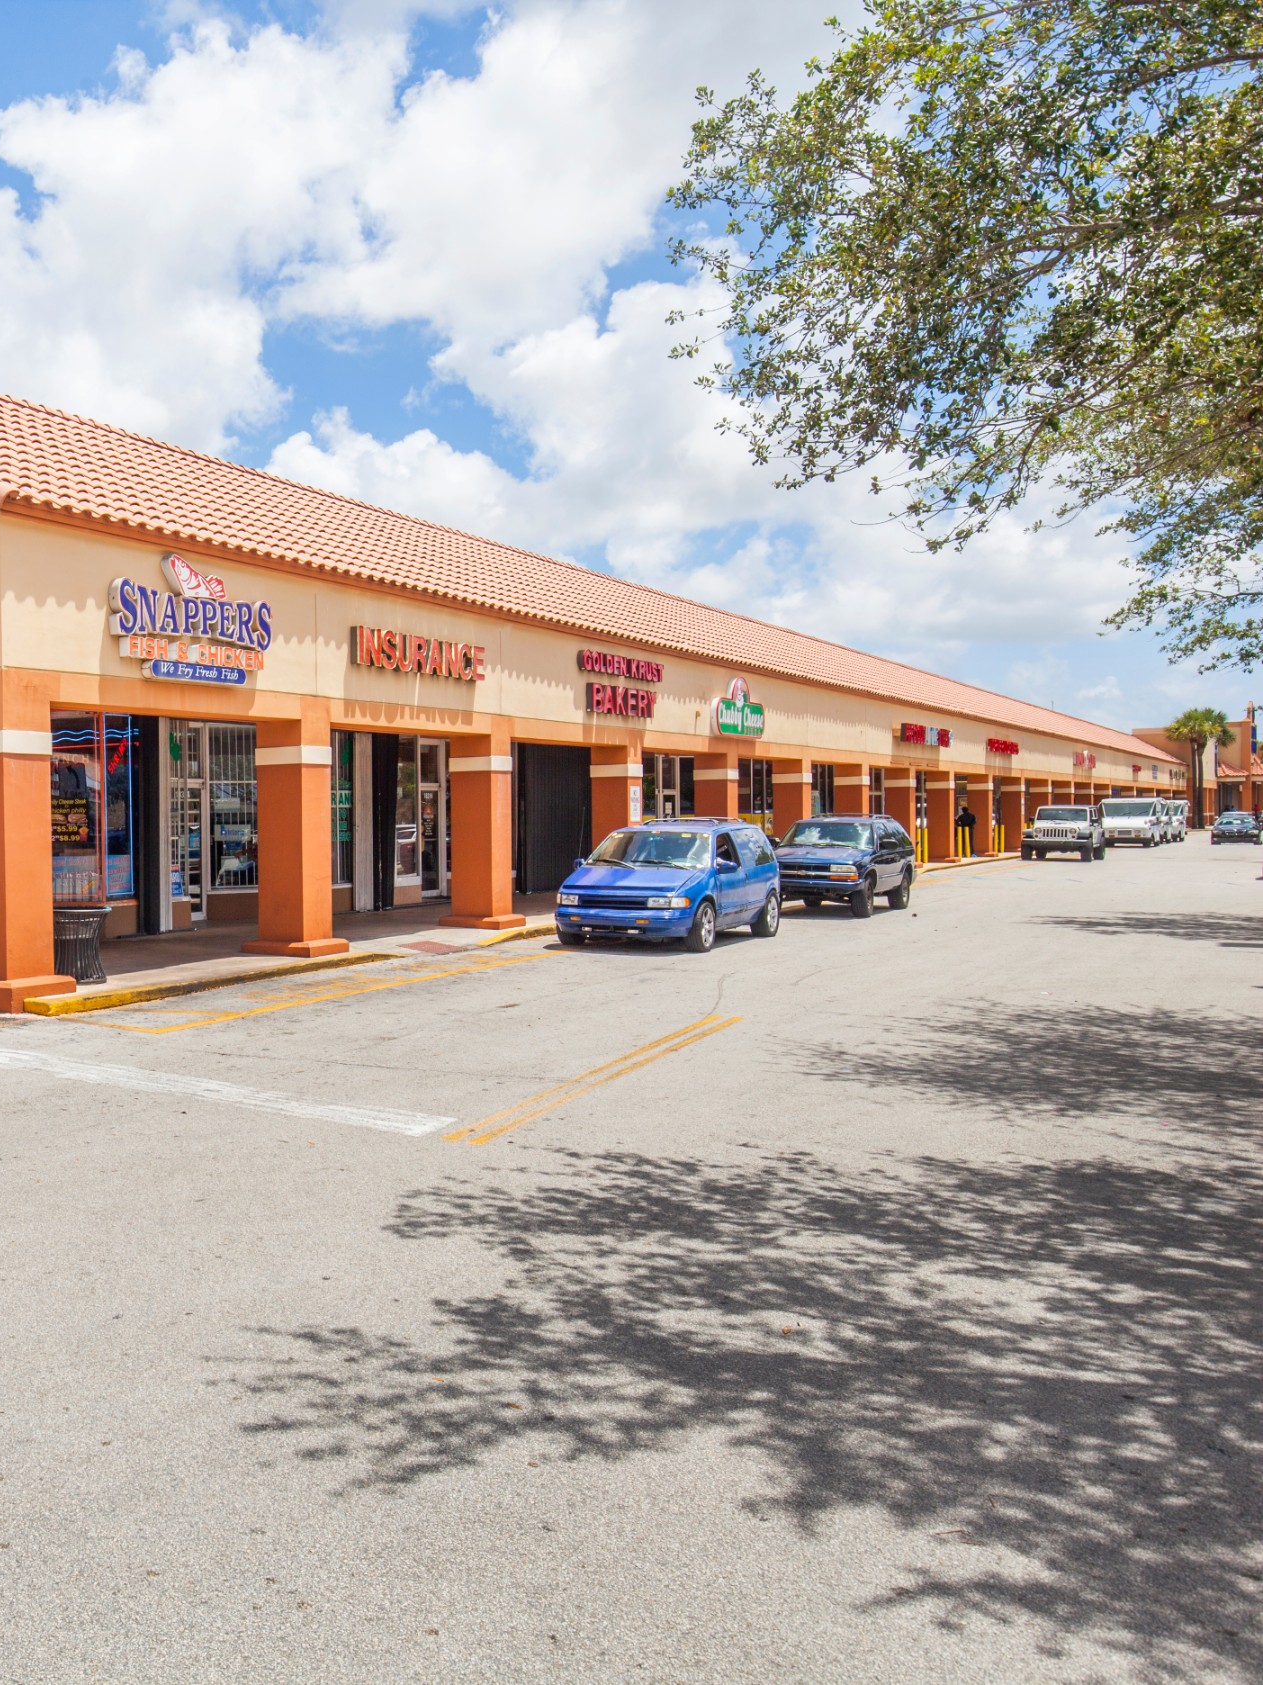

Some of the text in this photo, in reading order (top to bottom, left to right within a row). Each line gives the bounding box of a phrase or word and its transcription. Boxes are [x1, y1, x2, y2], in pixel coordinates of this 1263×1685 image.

[119, 577, 273, 652] SNAPPERS
[128, 636, 265, 671] FISH & CHICKEN
[356, 625, 485, 681] INSURANCE
[582, 649, 664, 683] GOLDEN KRUST
[160, 662, 239, 681] We Fry Fresh Fish
[592, 683, 657, 718] BAKERY
[744, 706, 764, 728] Cheese
